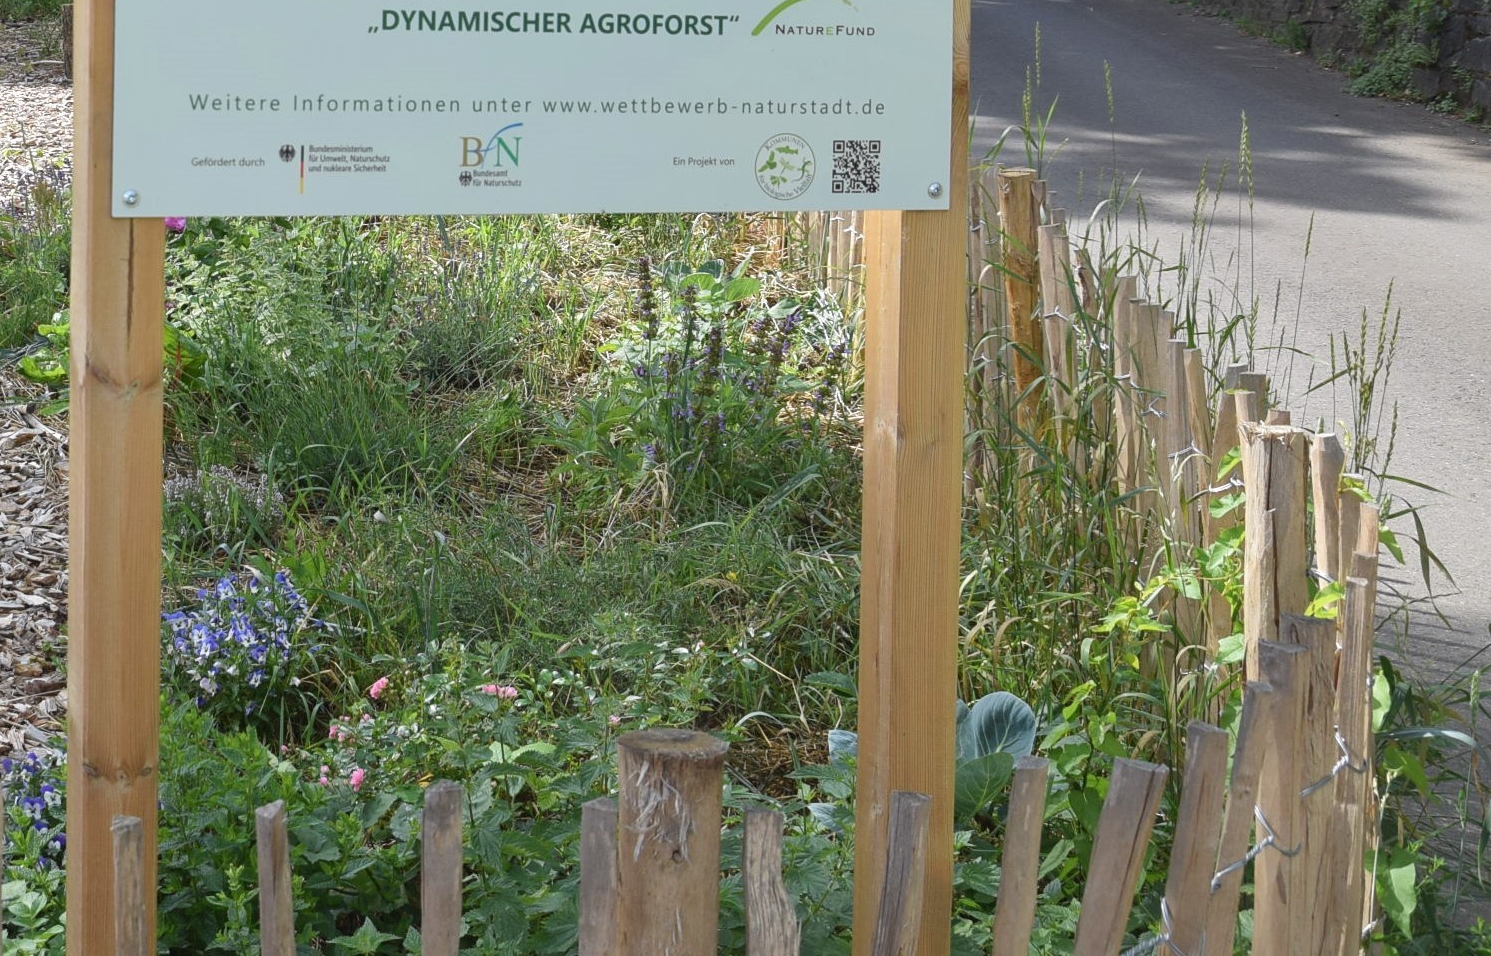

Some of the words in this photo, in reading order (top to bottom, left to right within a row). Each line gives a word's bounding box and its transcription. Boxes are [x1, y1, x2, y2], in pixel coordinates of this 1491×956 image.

[189, 94, 281, 112] Weitere
[293, 94, 461, 113] Informationen
[471, 97, 533, 114] unter
[542, 97, 885, 116] www.wettbewerb-naturstadt.de
[308, 144, 374, 154] Bundesministerium
[191, 156, 236, 168] Gefördert
[238, 156, 266, 168] durch
[308, 154, 318, 164] für
[320, 154, 349, 164] Umwelt,
[350, 155, 391, 164] Naturschutz
[673, 156, 686, 166] Ein
[688, 156, 716, 169] Projekt
[719, 158, 735, 166] von
[308, 164, 322, 173] und
[323, 164, 353, 173] nukleare
[354, 164, 387, 173] Sicherheit
[472, 169, 508, 178] Bundesamt
[483, 179, 522, 188] Naturschutz
